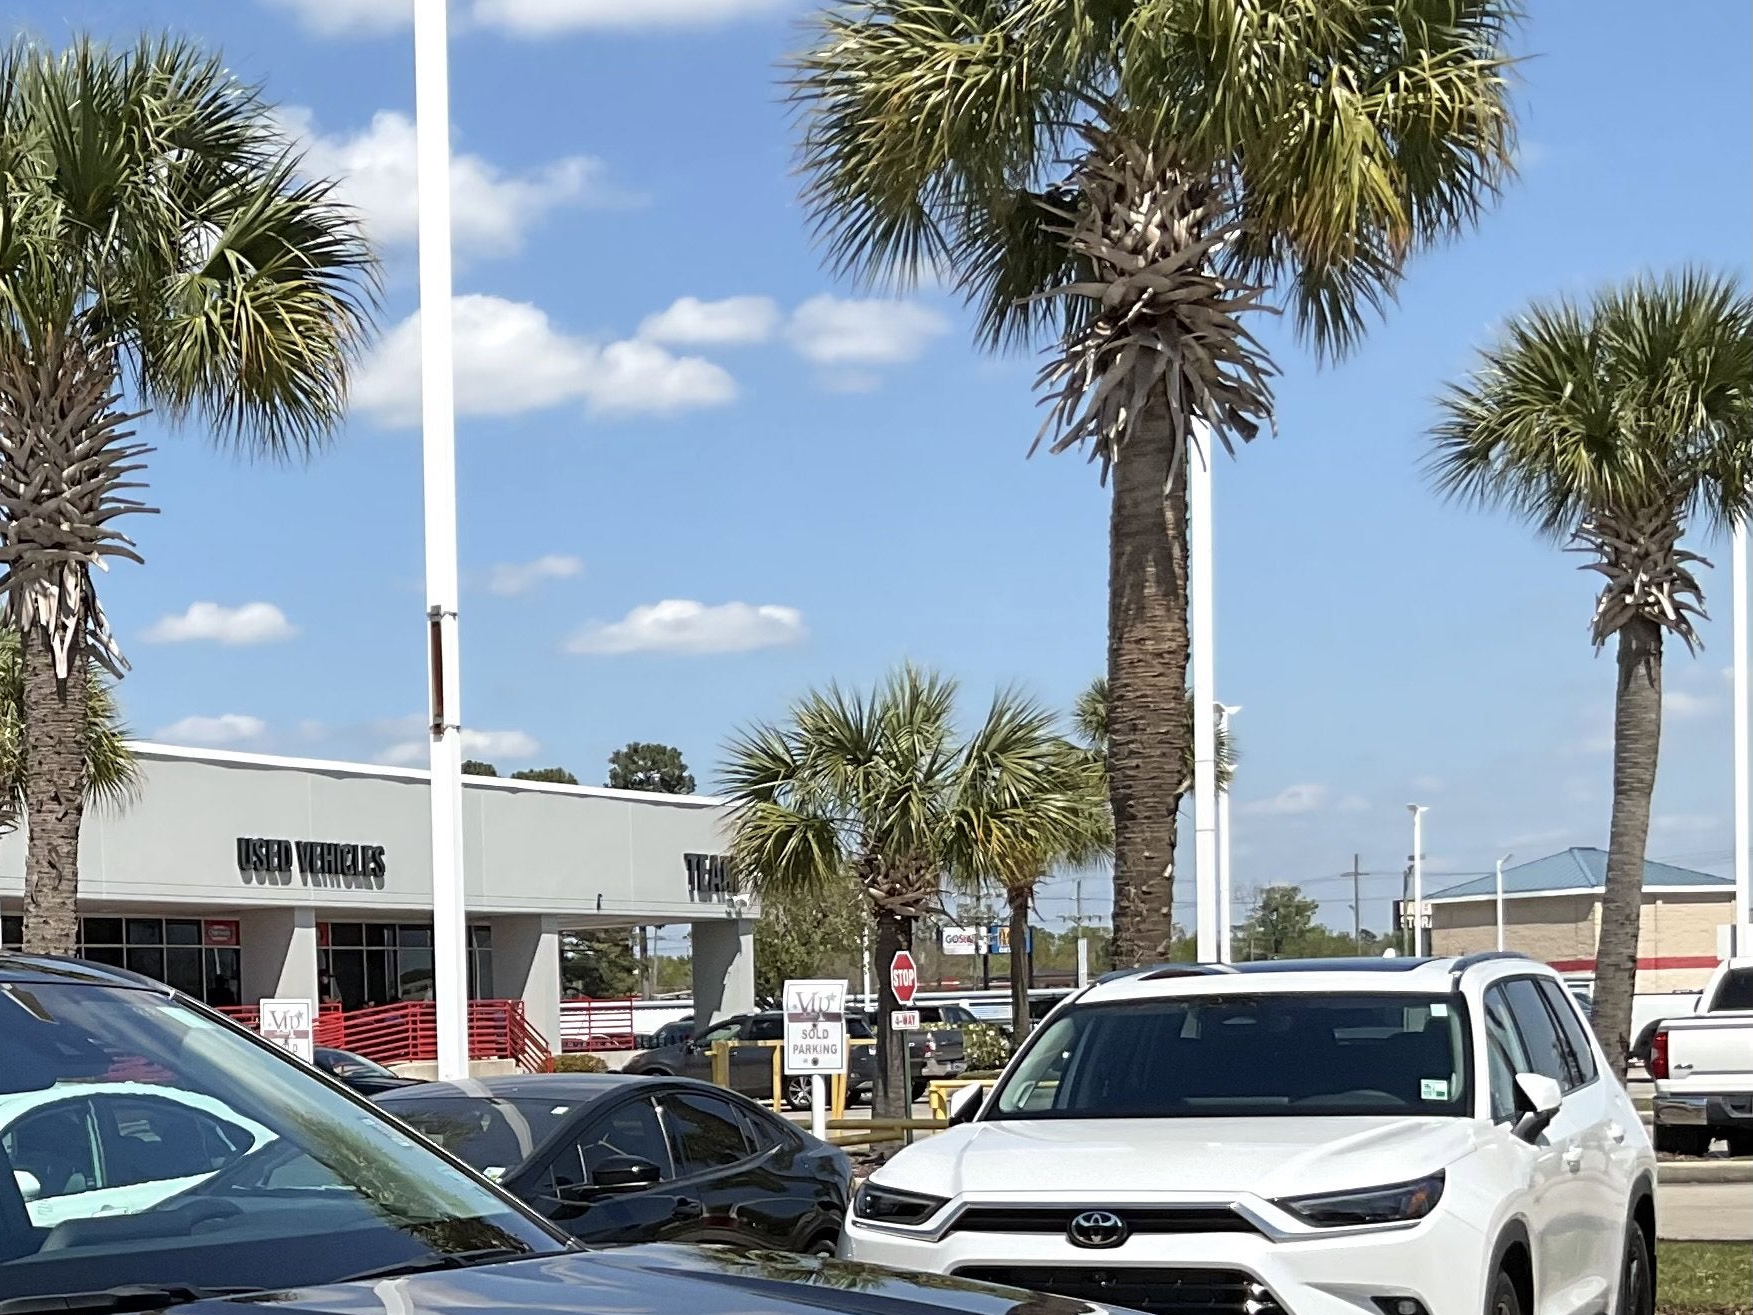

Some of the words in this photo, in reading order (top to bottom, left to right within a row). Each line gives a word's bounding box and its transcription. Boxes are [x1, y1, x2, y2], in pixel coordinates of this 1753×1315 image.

[237, 838, 292, 872] USED
[295, 841, 385, 877] VEHICLES
[894, 969, 914, 987] STOP
[895, 1014, 915, 1026] 4-WAY
[802, 1029, 829, 1039] SOLD
[793, 1044, 838, 1055] PARKING
